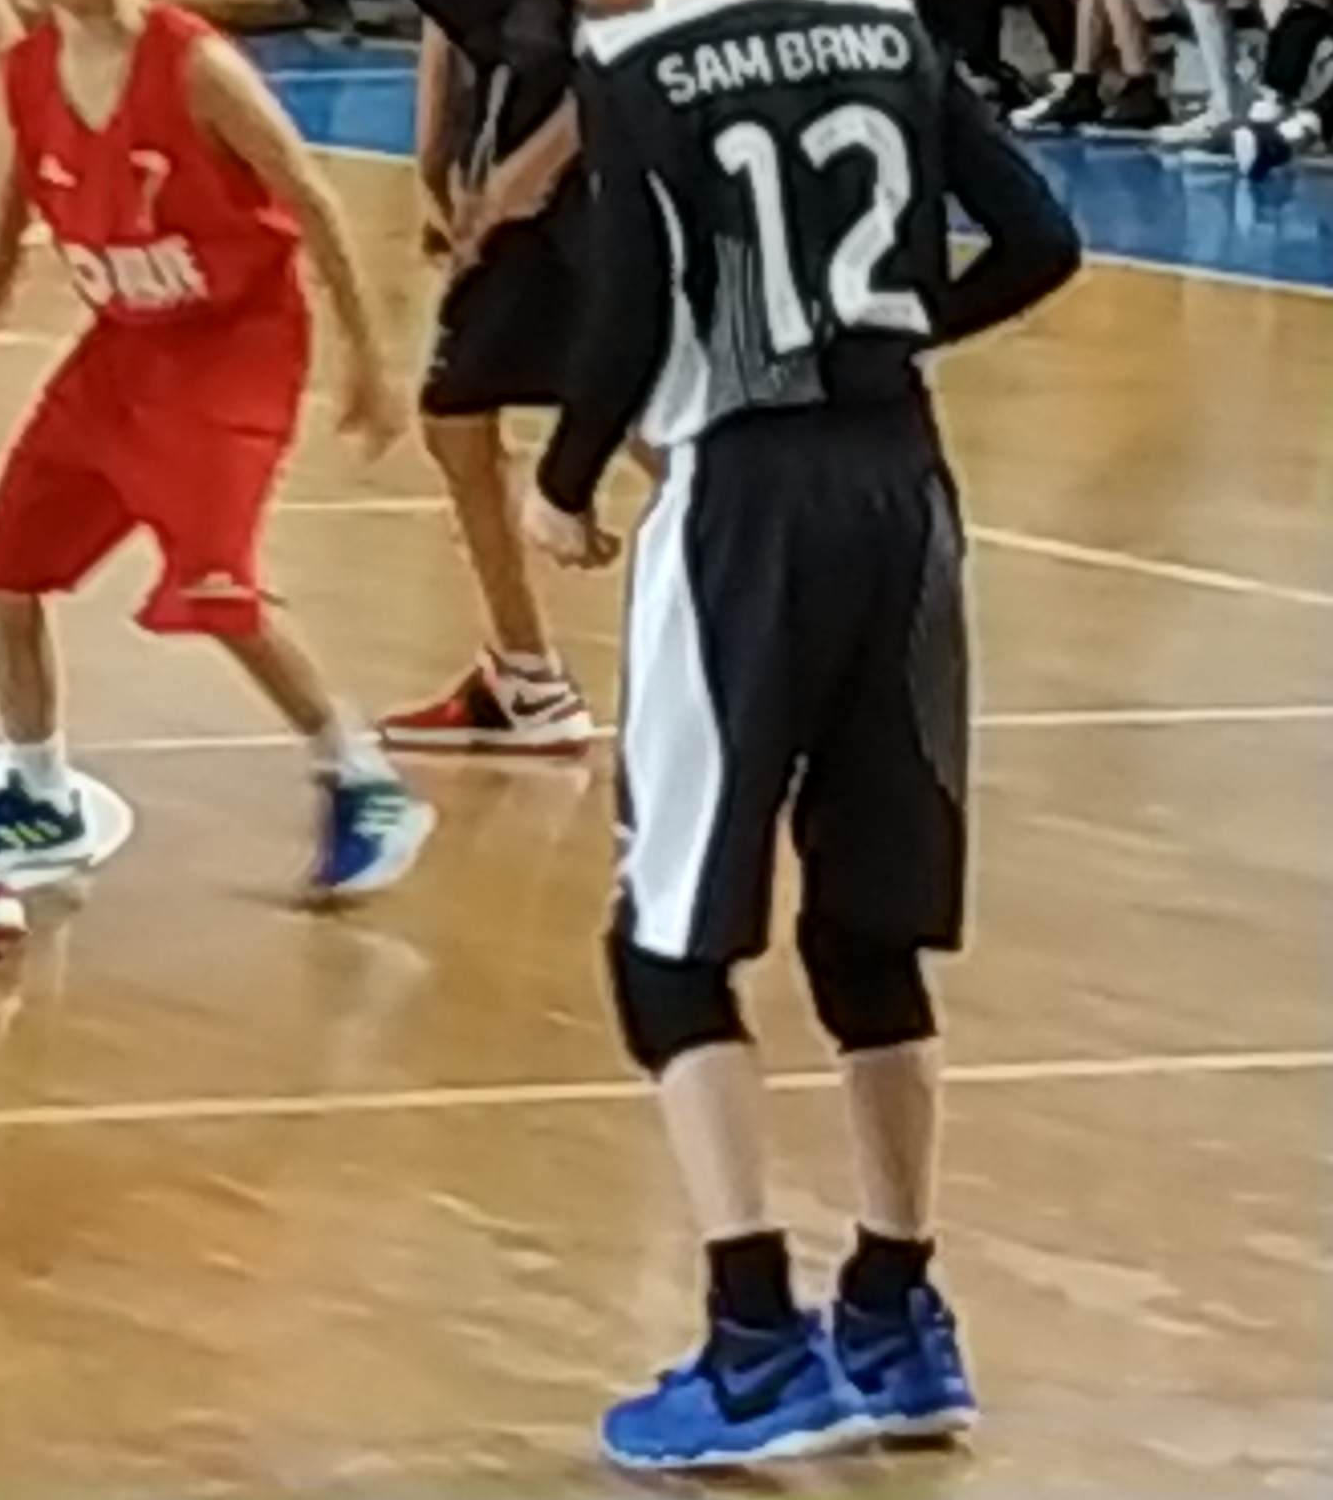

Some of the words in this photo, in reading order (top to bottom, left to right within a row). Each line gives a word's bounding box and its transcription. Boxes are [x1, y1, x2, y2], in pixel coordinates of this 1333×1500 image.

[657, 36, 773, 105] SAM
[776, 23, 912, 81] BRNO
[130, 149, 172, 235] 7
[714, 104, 931, 355] 12
